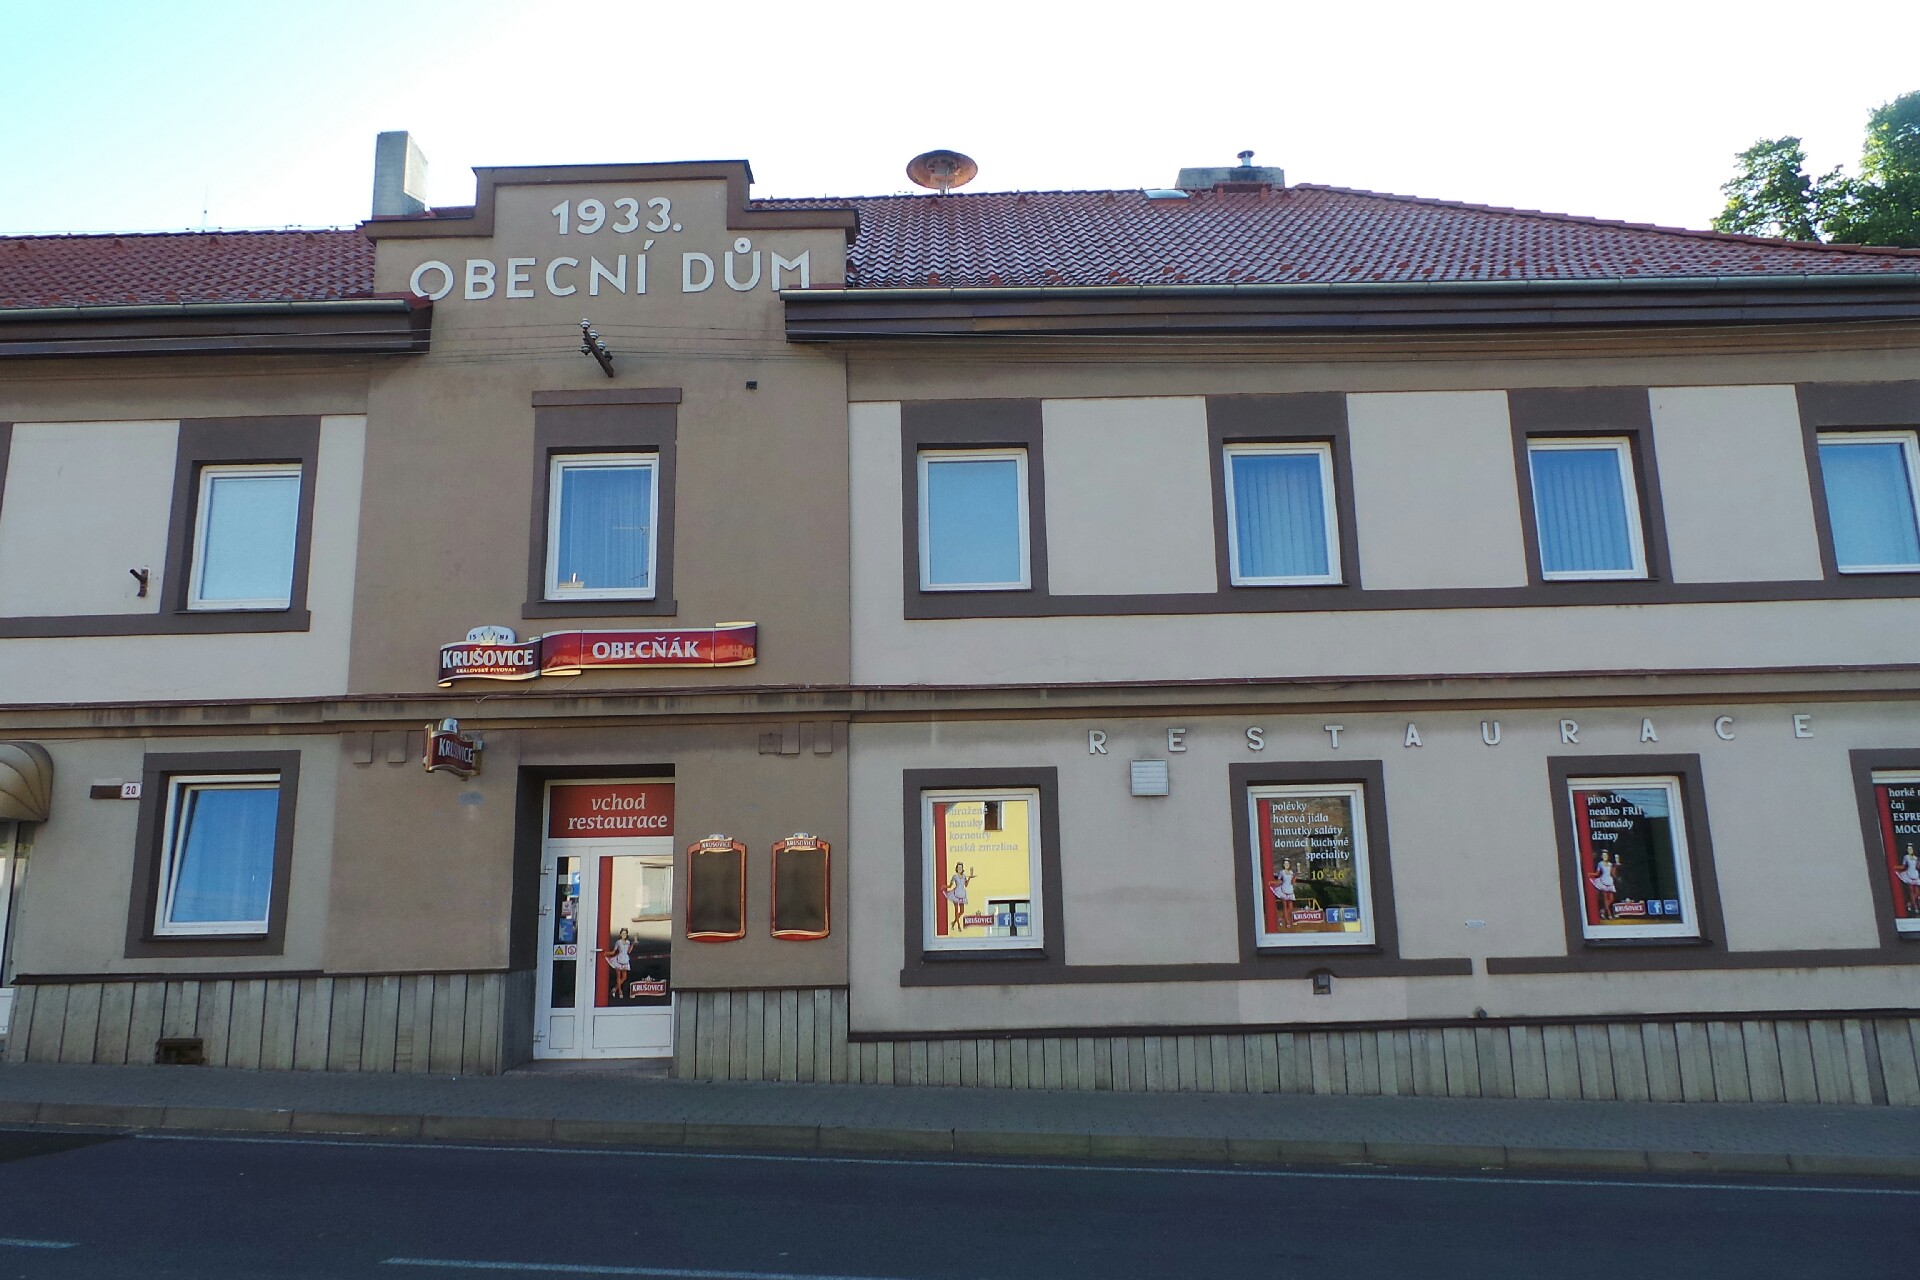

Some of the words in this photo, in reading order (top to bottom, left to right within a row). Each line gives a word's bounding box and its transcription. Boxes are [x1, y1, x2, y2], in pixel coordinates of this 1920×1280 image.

[552, 196, 683, 235] 1933.
[410, 239, 656, 300] OBECNÍ
[682, 237, 811, 293] DŮM
[592, 636, 700, 659] OBECŇÁK
[442, 647, 534, 669] KRUŠOVICE
[125, 785, 137, 795] 20
[1888, 787, 1916, 797] horké
[591, 793, 646, 811] vchod
[1587, 794, 1607, 806] pivo
[1891, 799, 1905, 811] čaj
[1272, 801, 1307, 813] polévky
[1589, 806, 1620, 816] nealko
[568, 815, 668, 830] restaurace
[949, 819, 983, 829] nanuky
[1273, 813, 1305, 823] hotová
[1590, 818, 1634, 830] limonády
[1274, 825, 1312, 837] minutky
[1315, 825, 1343, 836] saláty
[1592, 831, 1618, 842] džusy
[1274, 838, 1308, 848] domácí
[1306, 850, 1350, 861] speciality
